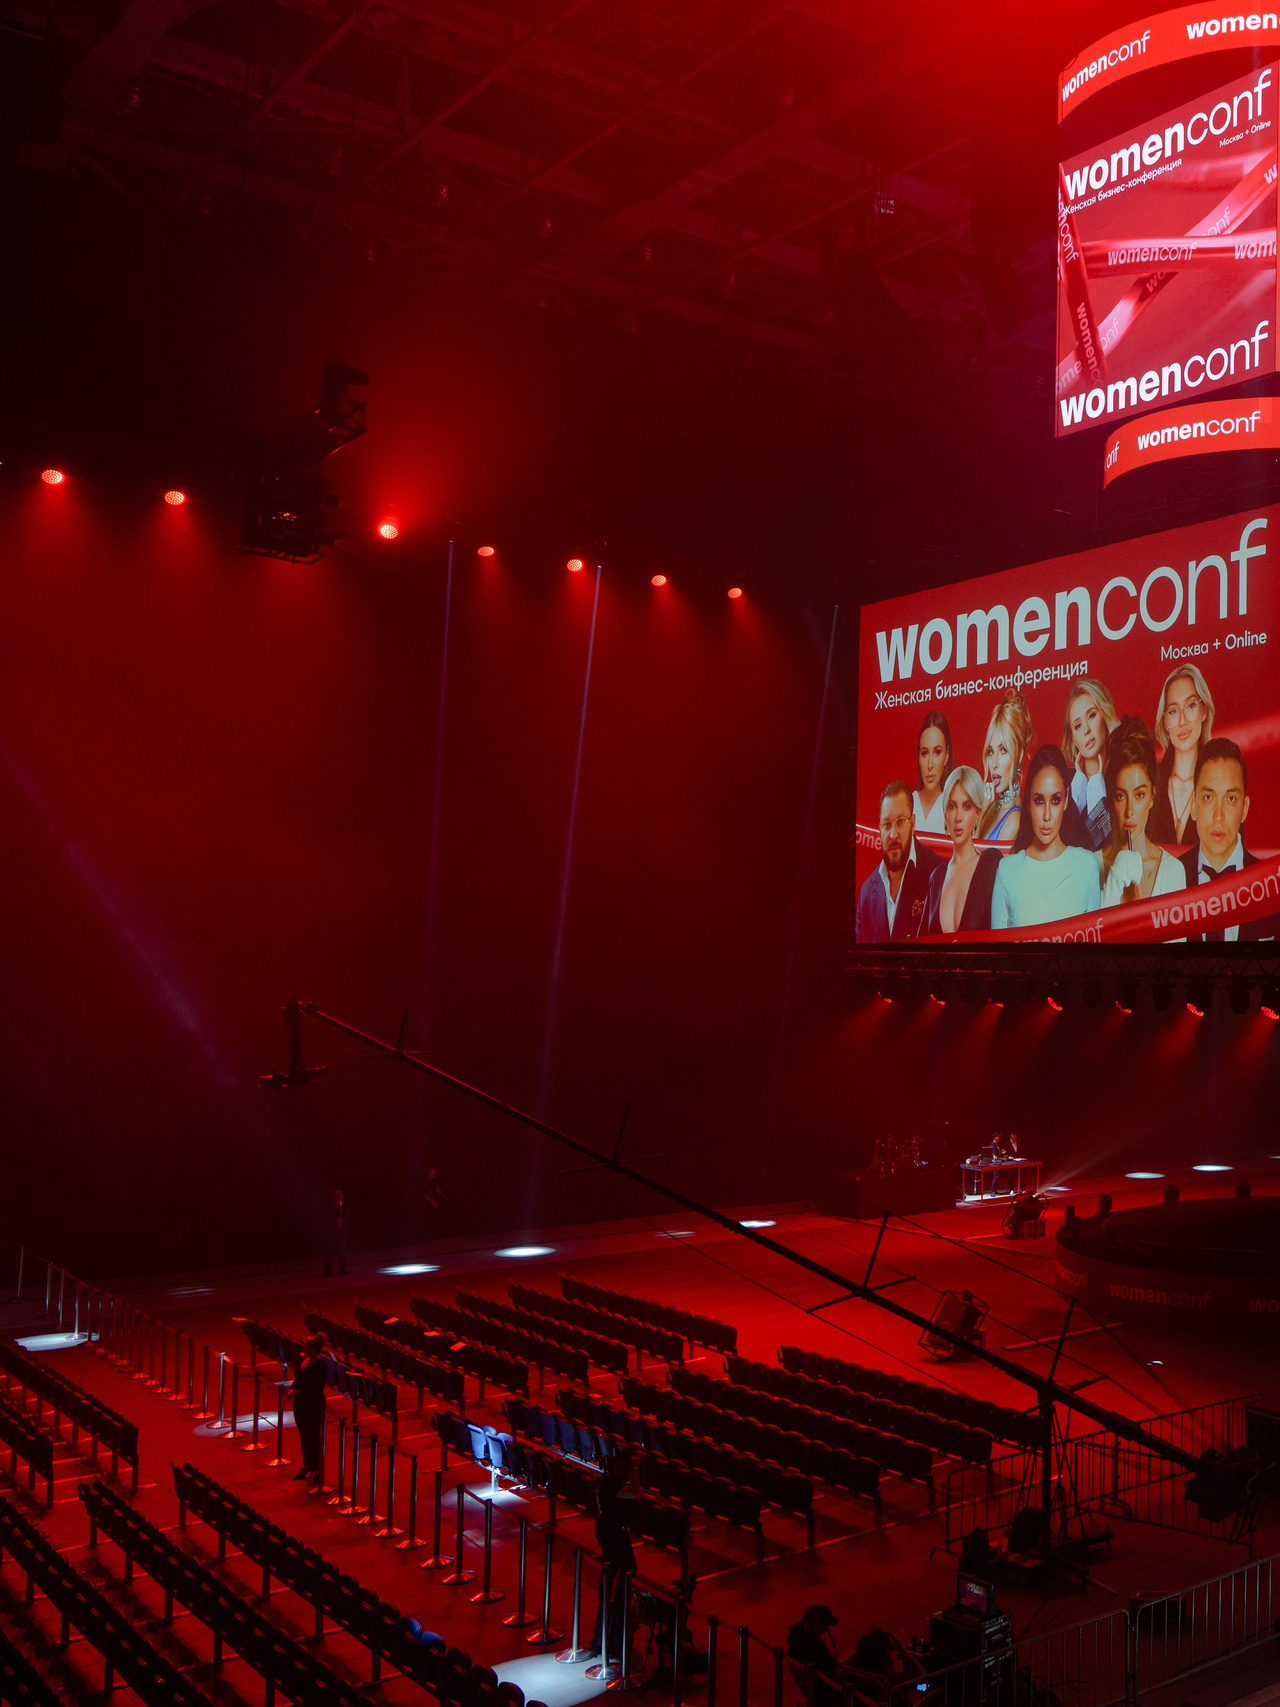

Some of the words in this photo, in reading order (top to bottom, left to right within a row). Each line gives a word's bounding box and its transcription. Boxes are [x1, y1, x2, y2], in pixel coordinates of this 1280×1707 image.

[1062, 30, 1151, 102] womenconf
[1064, 68, 1272, 200] womenconf
[1251, 120, 1271, 134] Online
[1063, 196, 1097, 217] Женская
[1098, 158, 1183, 202] бизнес-конференция
[1108, 242, 1197, 266] womenconf
[1060, 320, 1269, 427] womenconf
[1137, 411, 1261, 450] womenconf
[875, 518, 1268, 683] womenconf
[1160, 639, 1209, 661] Москва
[1225, 630, 1268, 651] Online
[874, 688, 932, 710] Женская
[935, 660, 1088, 701] бизнес-конференция
[1109, 1282, 1211, 1309] womenconf
